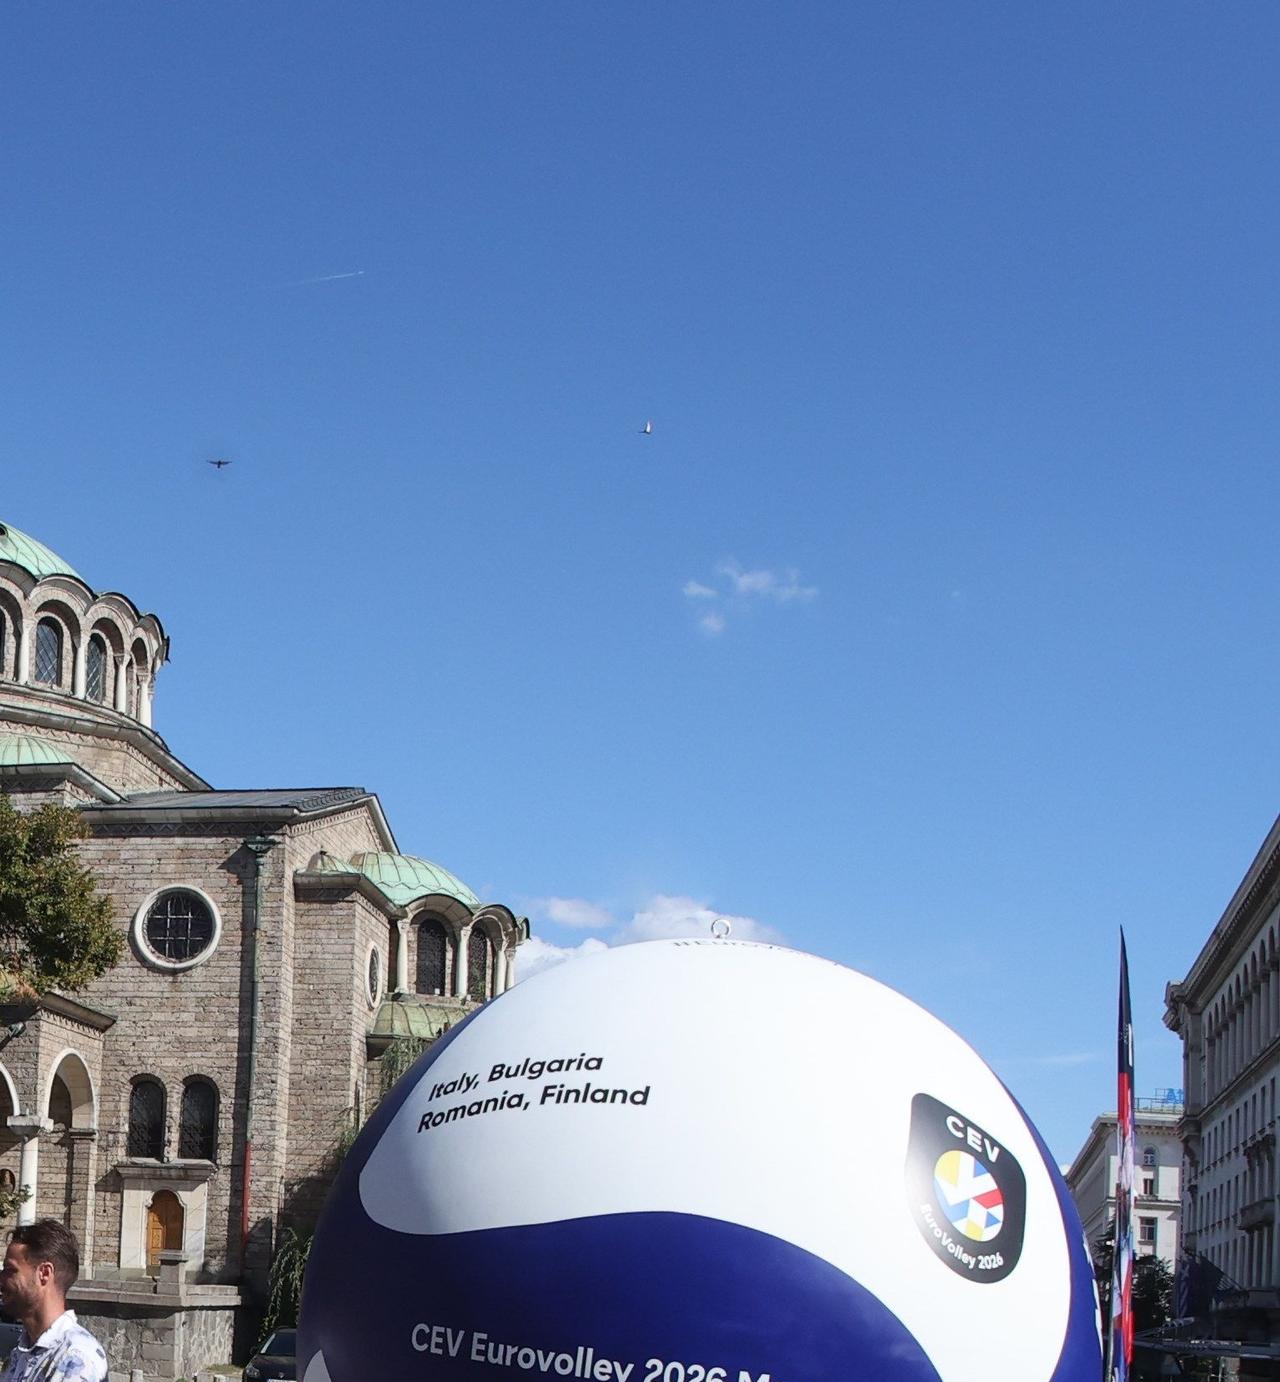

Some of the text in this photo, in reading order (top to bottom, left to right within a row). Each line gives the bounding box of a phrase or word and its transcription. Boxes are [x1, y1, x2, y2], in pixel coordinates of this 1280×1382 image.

[427, 1053, 604, 1102] Italy, Bulgaria
[416, 1082, 651, 1134] Romania, Finland
[945, 1115, 1000, 1163] CEV
[920, 1203, 1004, 1271] EuroVolley 2026
[411, 1323, 465, 1357] CEV
